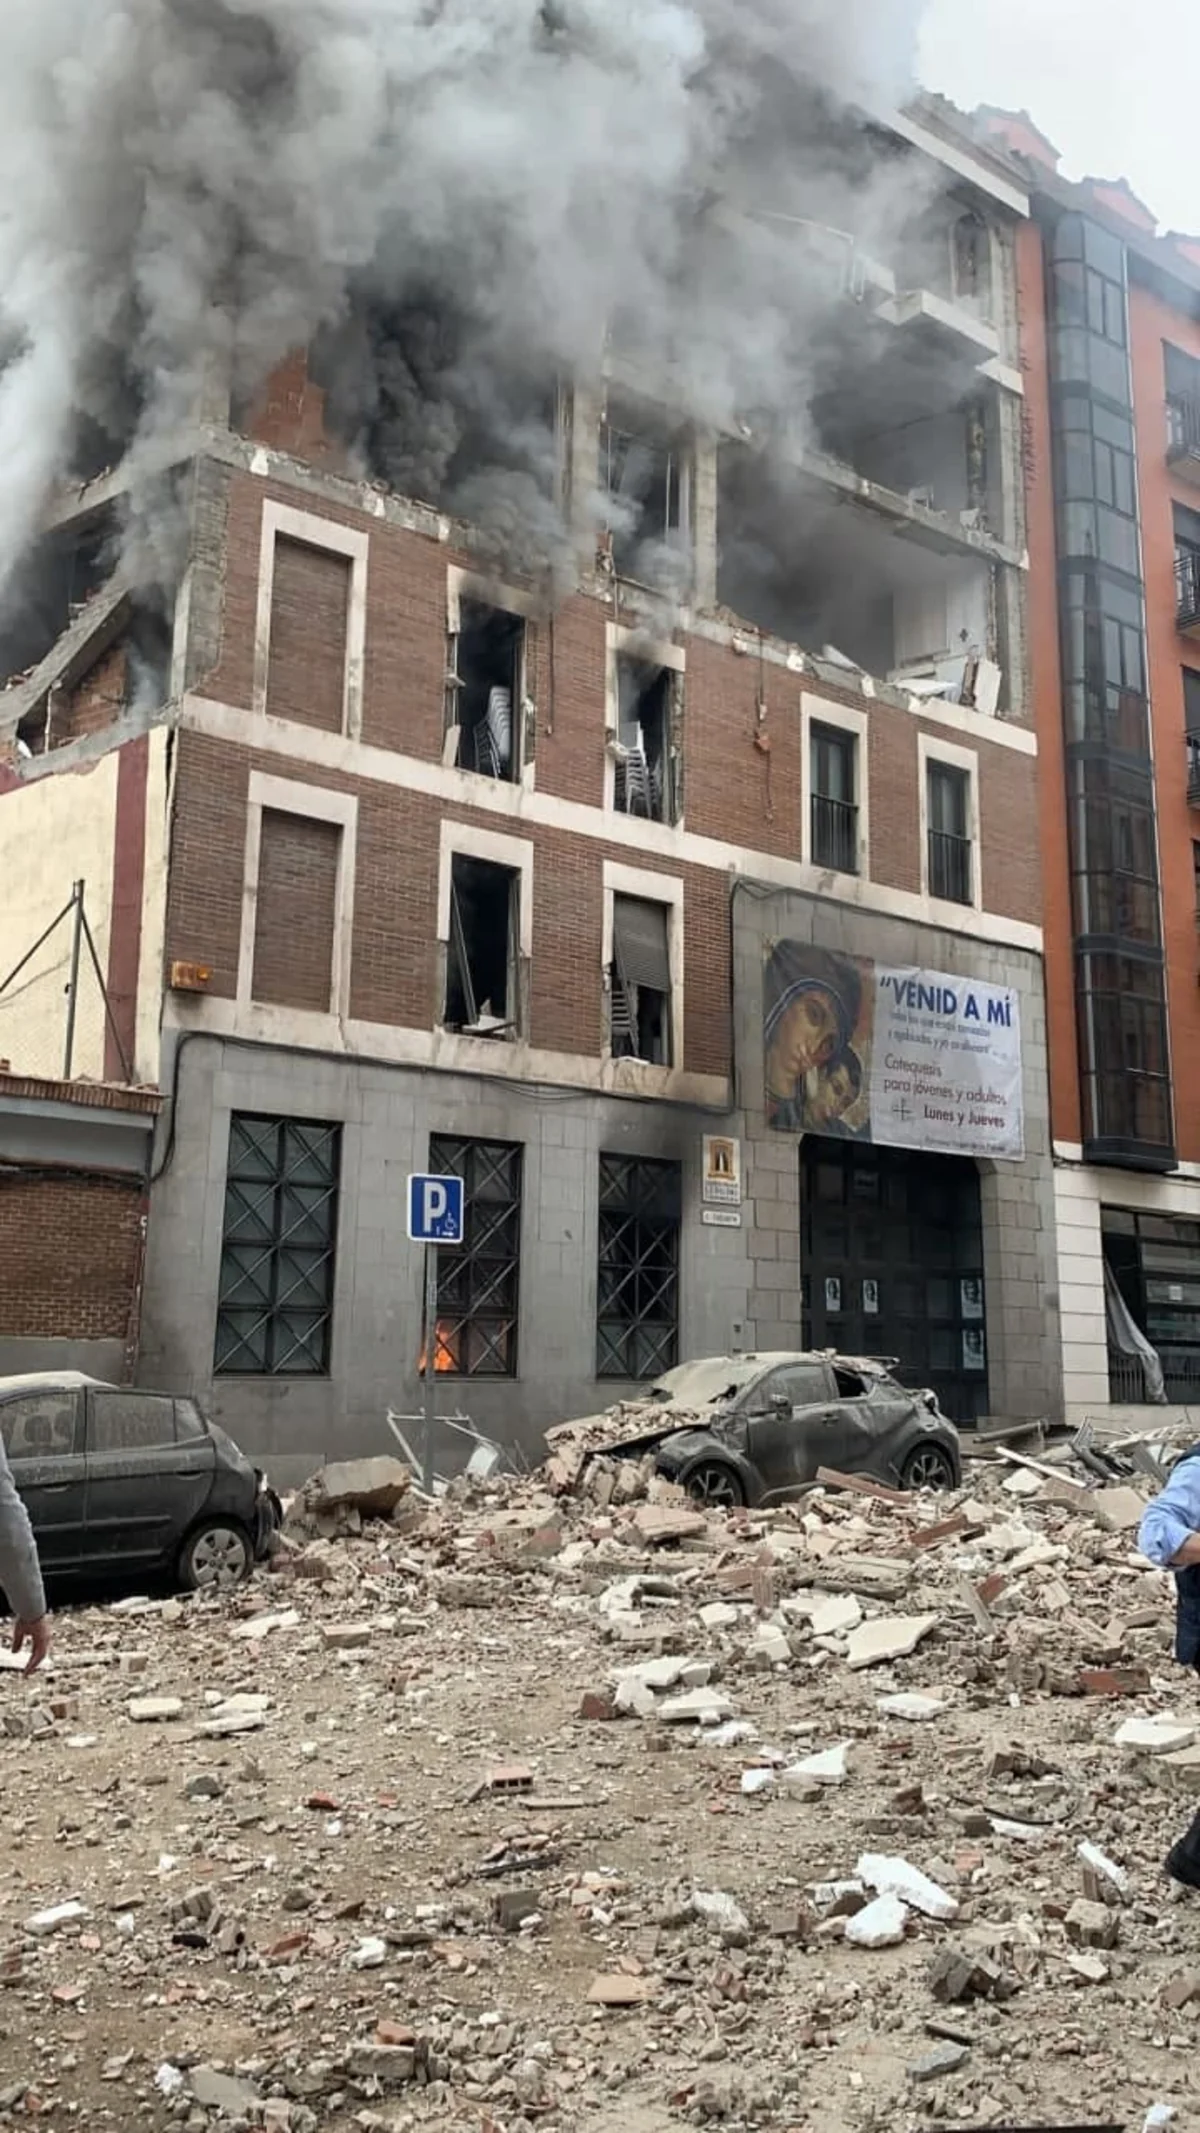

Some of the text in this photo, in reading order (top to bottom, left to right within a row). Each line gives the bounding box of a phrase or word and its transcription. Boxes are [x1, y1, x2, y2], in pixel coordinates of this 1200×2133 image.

[964, 993, 980, 1020] A
[988, 995, 1011, 1027] MÍ
[884, 1053, 942, 1081] Catequesis
[884, 1079, 911, 1094] para
[913, 1079, 953, 1099] jóvenes
[956, 1090, 964, 1104] y
[924, 1104, 1005, 1129] Lunes y Jueves
[423, 1181, 446, 1233] P
